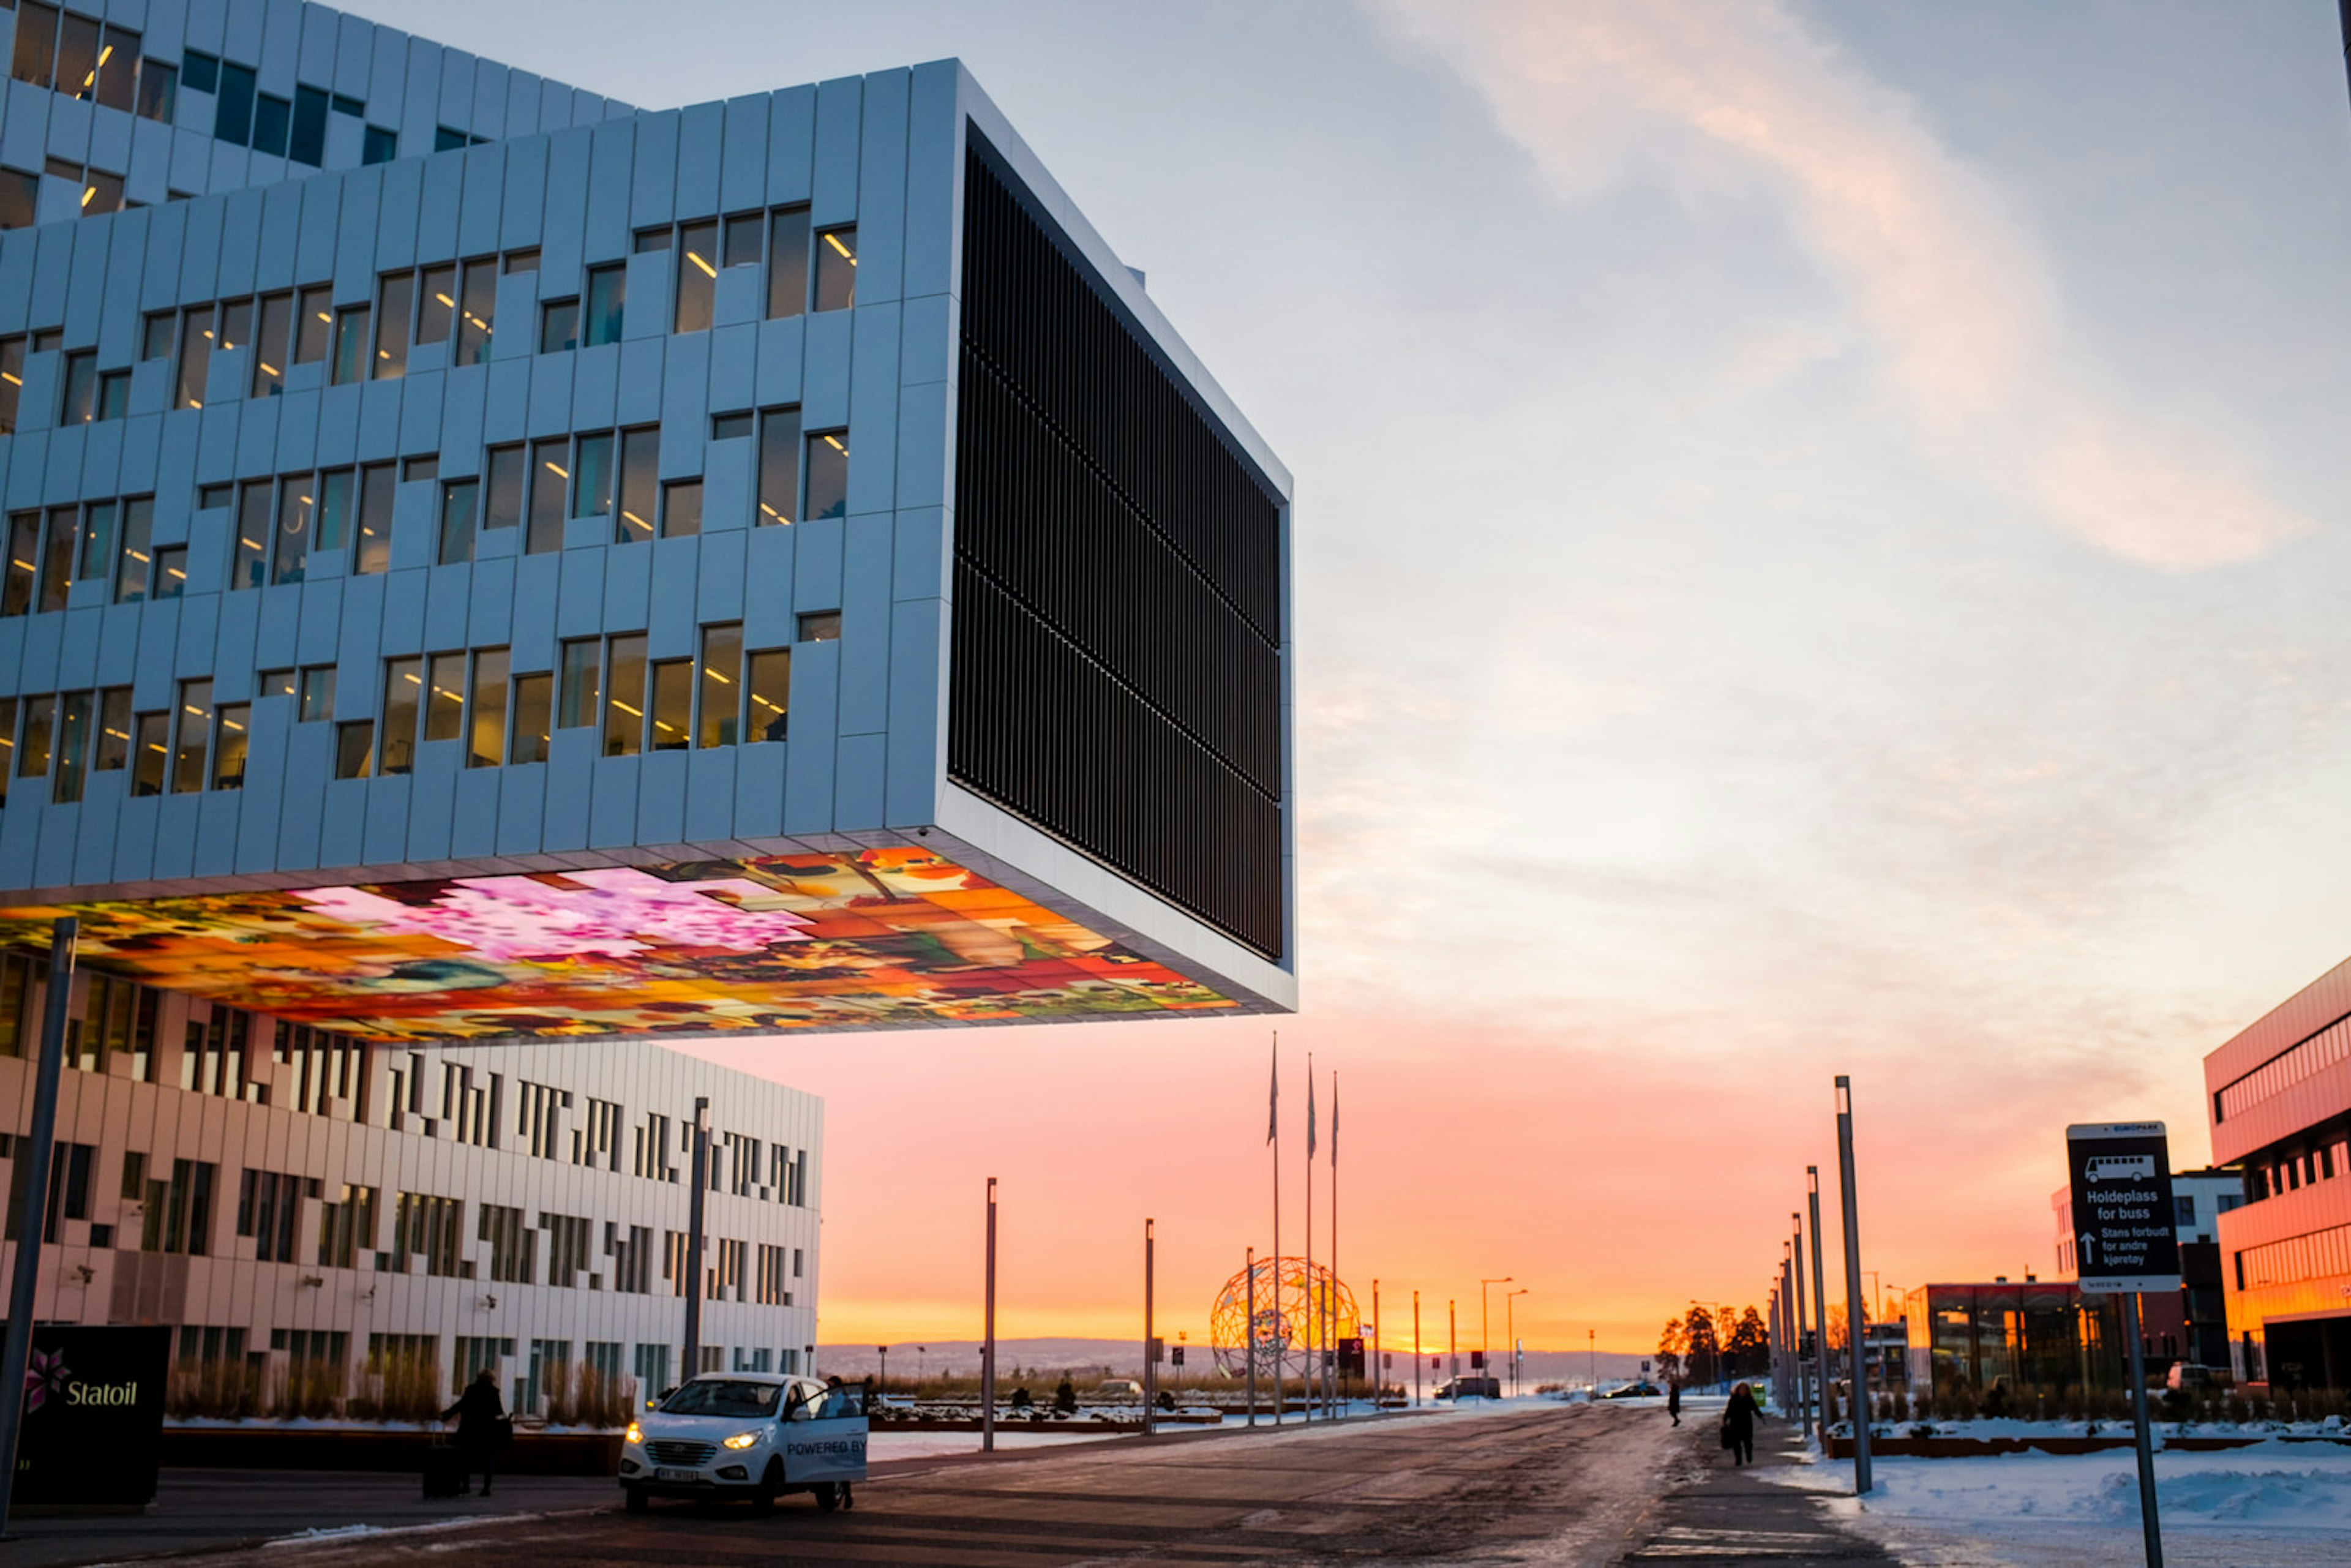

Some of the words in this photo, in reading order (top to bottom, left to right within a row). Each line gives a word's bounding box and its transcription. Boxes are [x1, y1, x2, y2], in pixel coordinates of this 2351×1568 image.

[2087, 1189, 2158, 1205] Holdeplass
[2098, 1206, 2116, 1220] for
[2118, 1206, 2150, 1220] buss
[2101, 1226, 2130, 1237] Stans
[2131, 1226, 2169, 1237] forbudt
[2102, 1240, 2117, 1251] for
[2119, 1240, 2148, 1251] andre
[66, 1381, 137, 1406] Statoil
[787, 1441, 847, 1456] POWERED
[852, 1439, 867, 1452] BY
